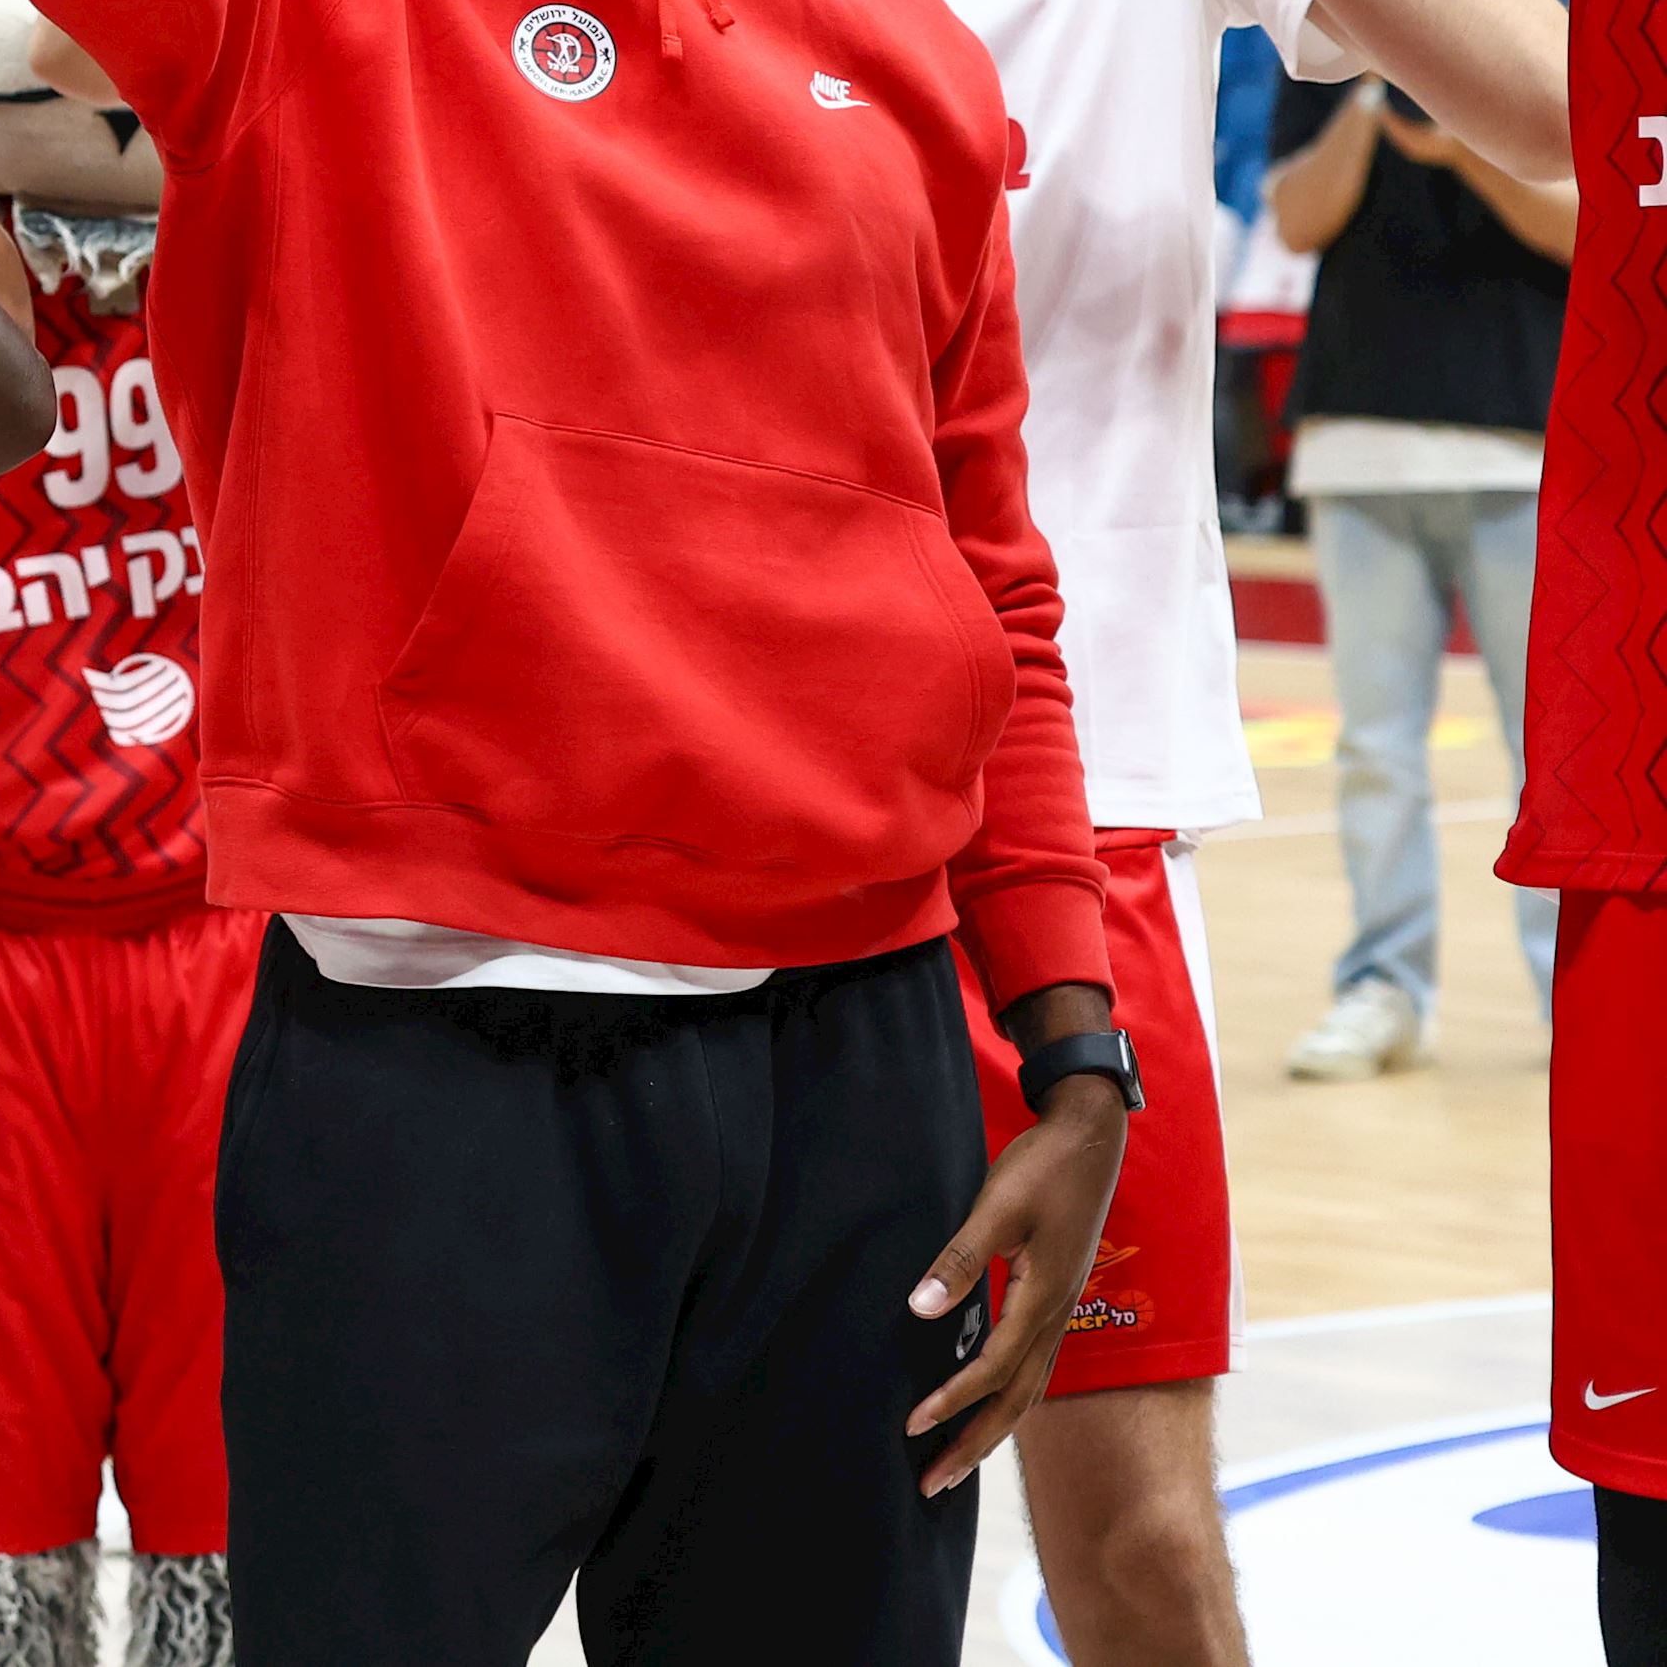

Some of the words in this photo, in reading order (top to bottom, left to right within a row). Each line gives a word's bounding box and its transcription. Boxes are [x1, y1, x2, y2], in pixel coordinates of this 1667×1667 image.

[572, 10, 606, 42] הפועל
[813, 70, 852, 102] NIKE
[41, 357, 184, 511] 99
[1110, 1308, 1136, 1326] סל
